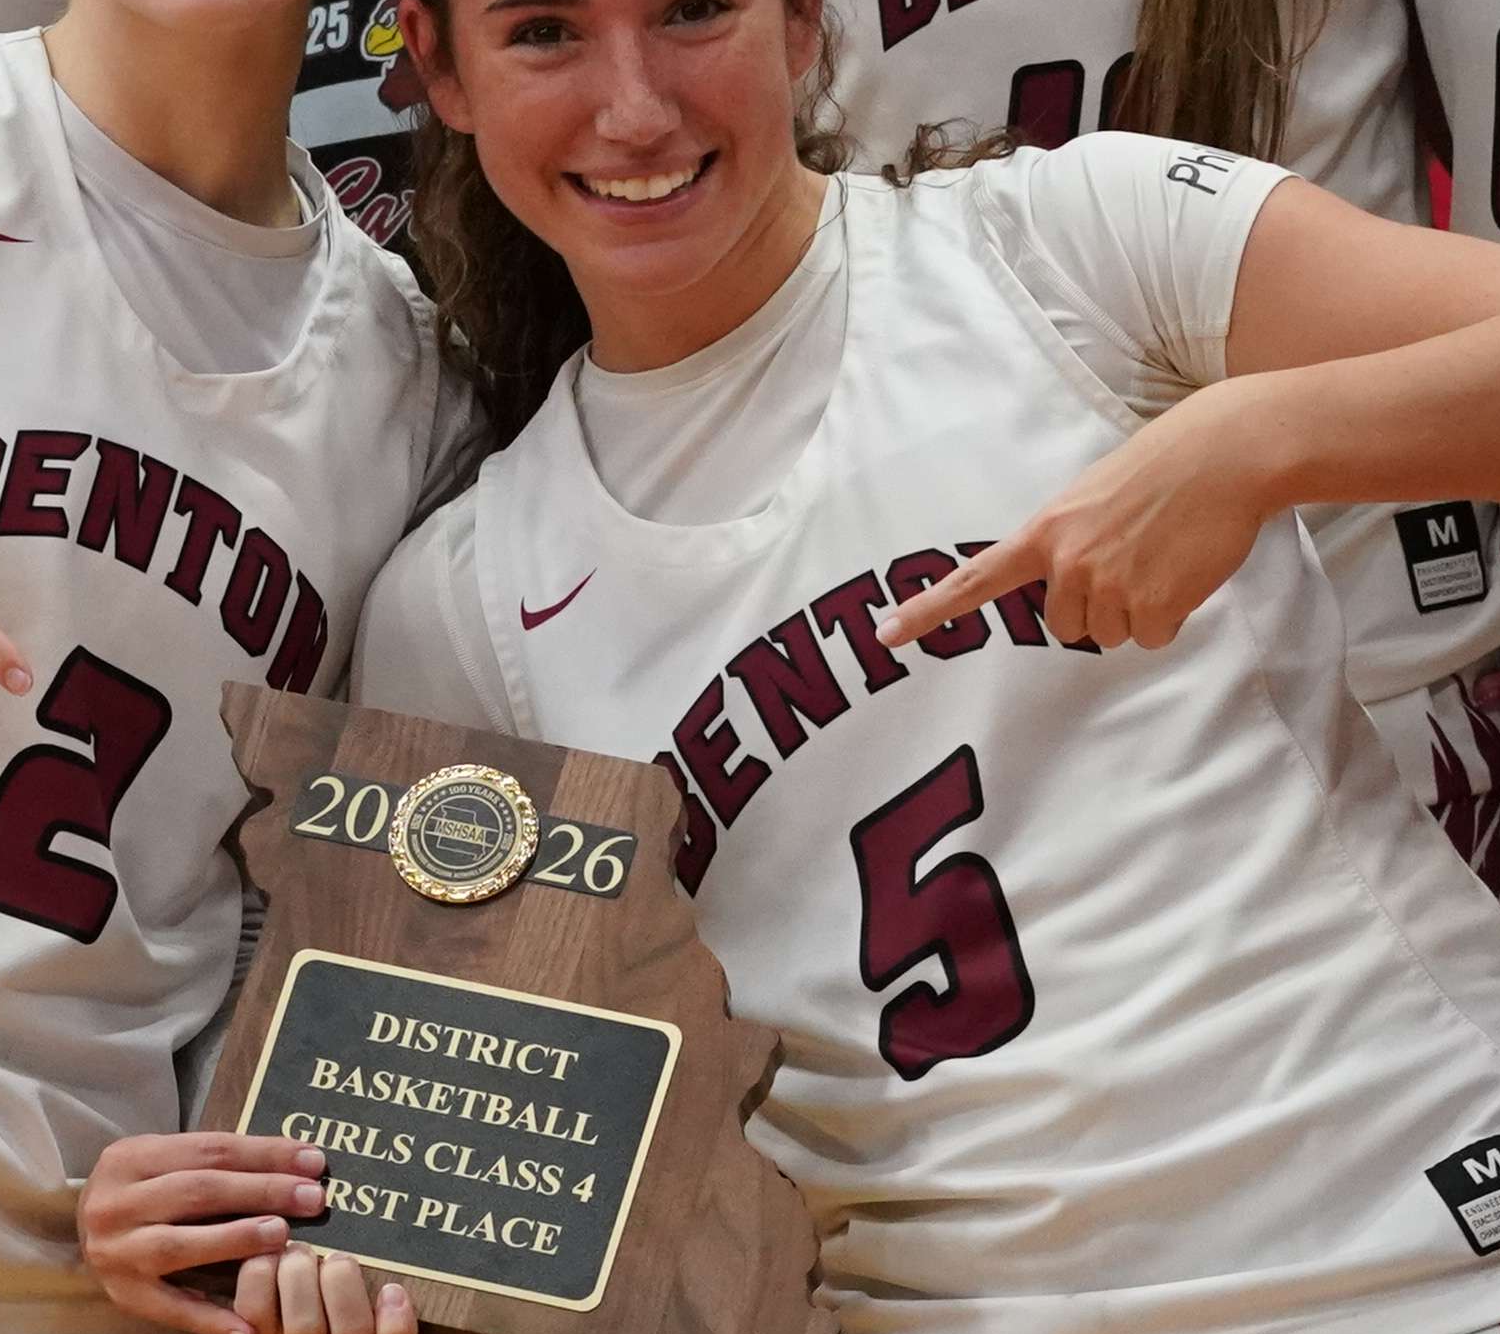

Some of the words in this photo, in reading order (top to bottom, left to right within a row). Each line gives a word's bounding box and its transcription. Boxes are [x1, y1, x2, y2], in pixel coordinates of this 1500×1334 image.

[305, 0, 350, 56] 25
[1426, 515, 1460, 548] M
[468, 784, 502, 805] YEARS
[436, 821, 485, 843] MSHSAA
[849, 742, 1036, 1082] 5
[365, 1010, 580, 1082] DISTRICT
[307, 1057, 600, 1147] BASKETBALL
[279, 1111, 417, 1165] GIRLS
[423, 1140, 566, 1197] CLASS
[571, 1172, 598, 1204] 4
[323, 1176, 409, 1223] RST
[411, 1196, 564, 1257] PLACE
